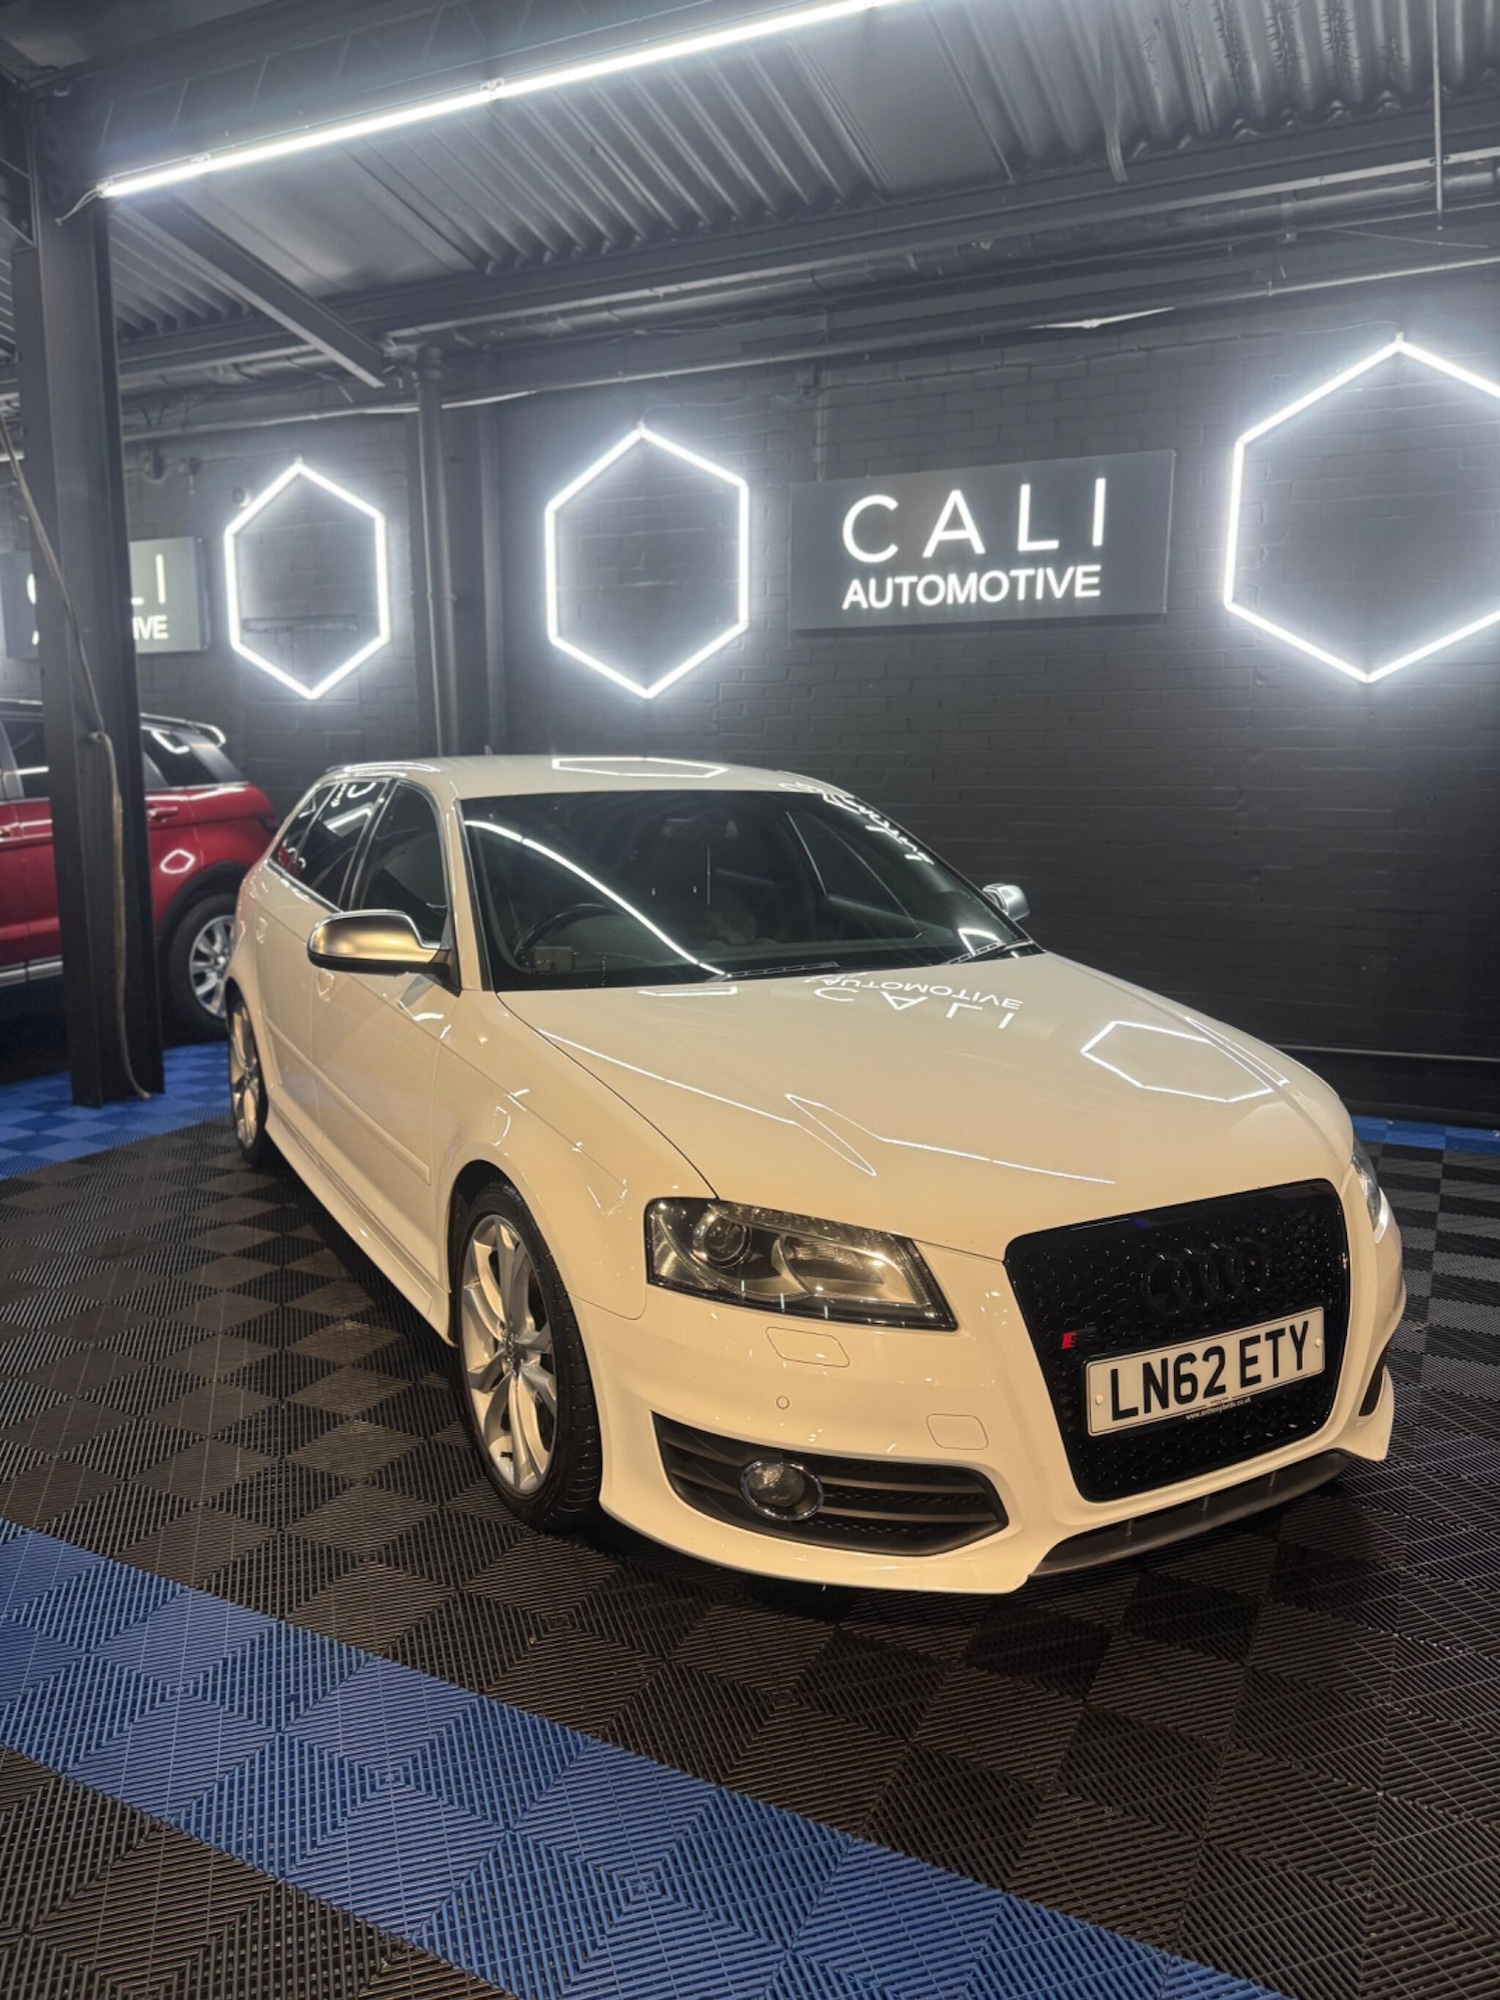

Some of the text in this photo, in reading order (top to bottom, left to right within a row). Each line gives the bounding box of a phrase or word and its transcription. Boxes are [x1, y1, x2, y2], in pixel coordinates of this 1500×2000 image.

[842, 477, 1106, 563] CALI
[842, 565, 1101, 610] AUTOMOTIVE
[1110, 1321, 1309, 1422] LN62 ETY
